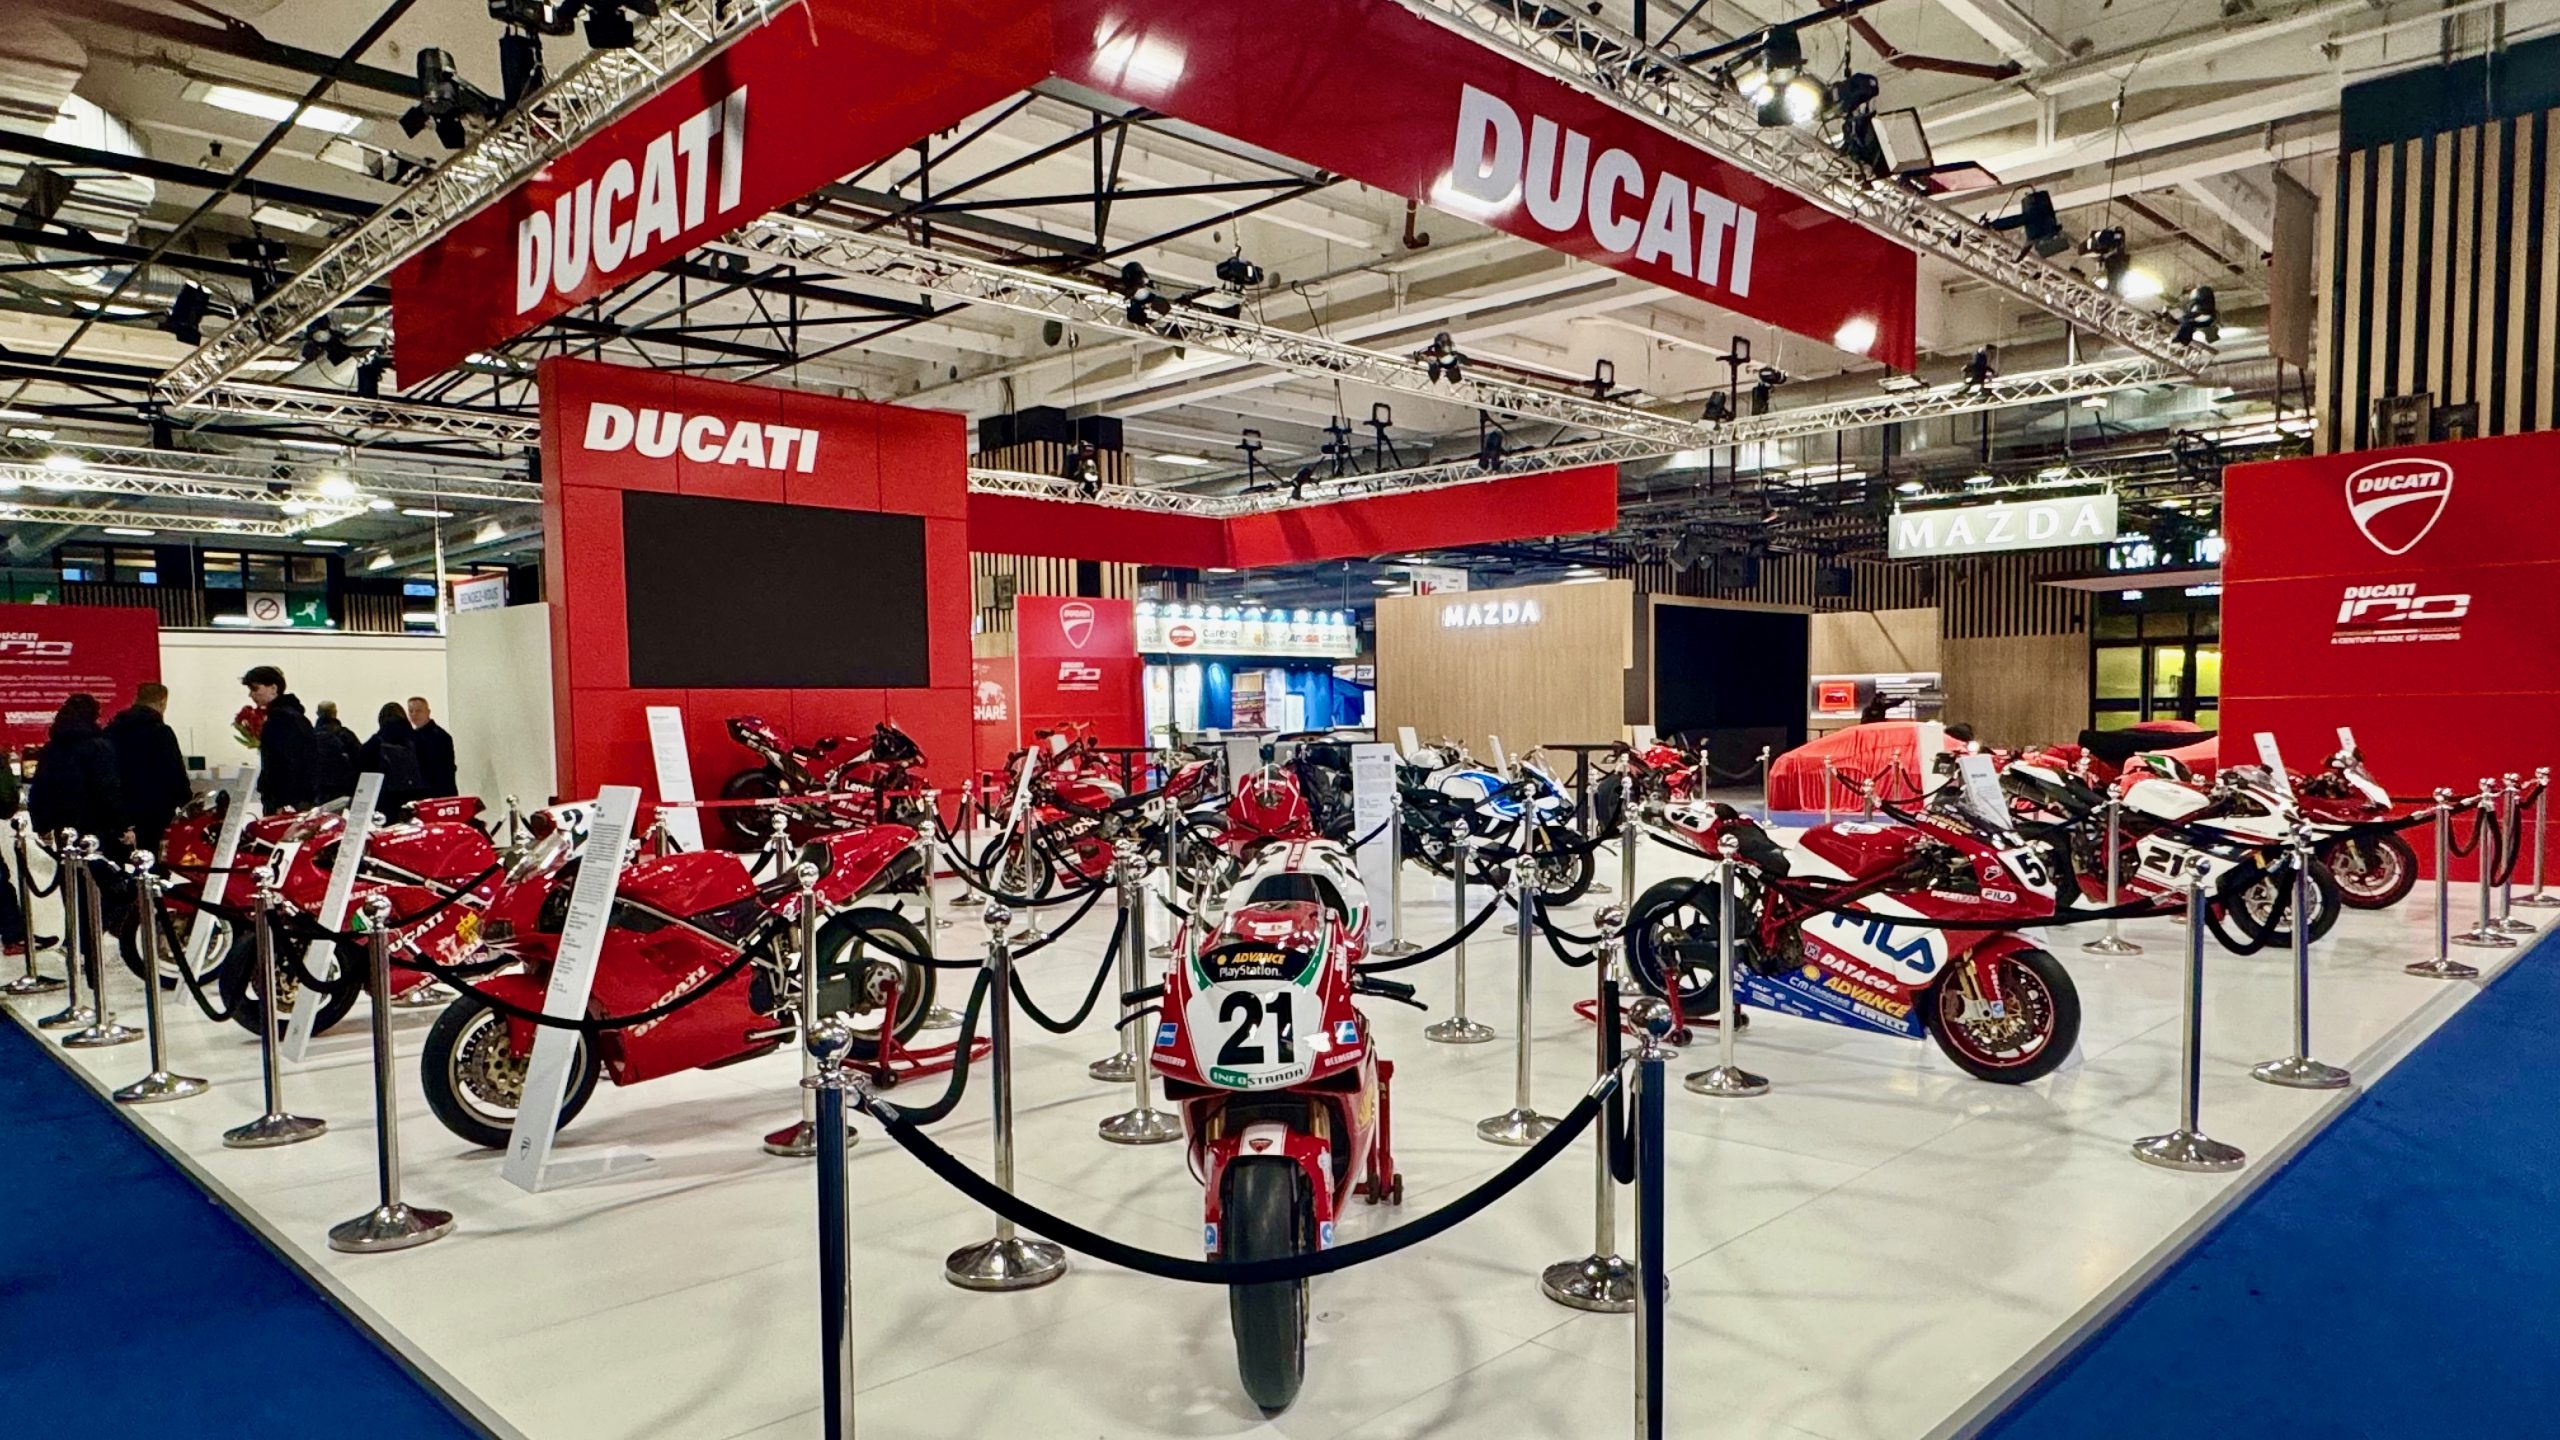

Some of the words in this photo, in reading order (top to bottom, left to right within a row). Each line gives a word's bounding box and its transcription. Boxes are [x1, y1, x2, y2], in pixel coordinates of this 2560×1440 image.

[517, 84, 748, 316] DUCATI
[1451, 82, 1758, 298] DUCATI
[583, 401, 820, 474] DUCATI
[2356, 471, 2441, 494] DUCATI
[1898, 503, 2104, 551] MAZDA
[2343, 583, 2417, 600] DUCATI
[1443, 600, 1540, 628] MAZDA
[2016, 852, 2047, 888] 5
[2144, 846, 2185, 878] 21
[1984, 890, 2013, 903] FILA
[1831, 905, 1937, 974] FILA
[1219, 964, 1279, 979] PlayStation
[1231, 952, 1287, 966] ADVANCE
[1819, 952, 1899, 995] DATACOL
[1822, 975, 1913, 1019] ADVANCE
[1216, 990, 1295, 1066] 21
[1212, 1067, 1305, 1087] INFOSTRADA
